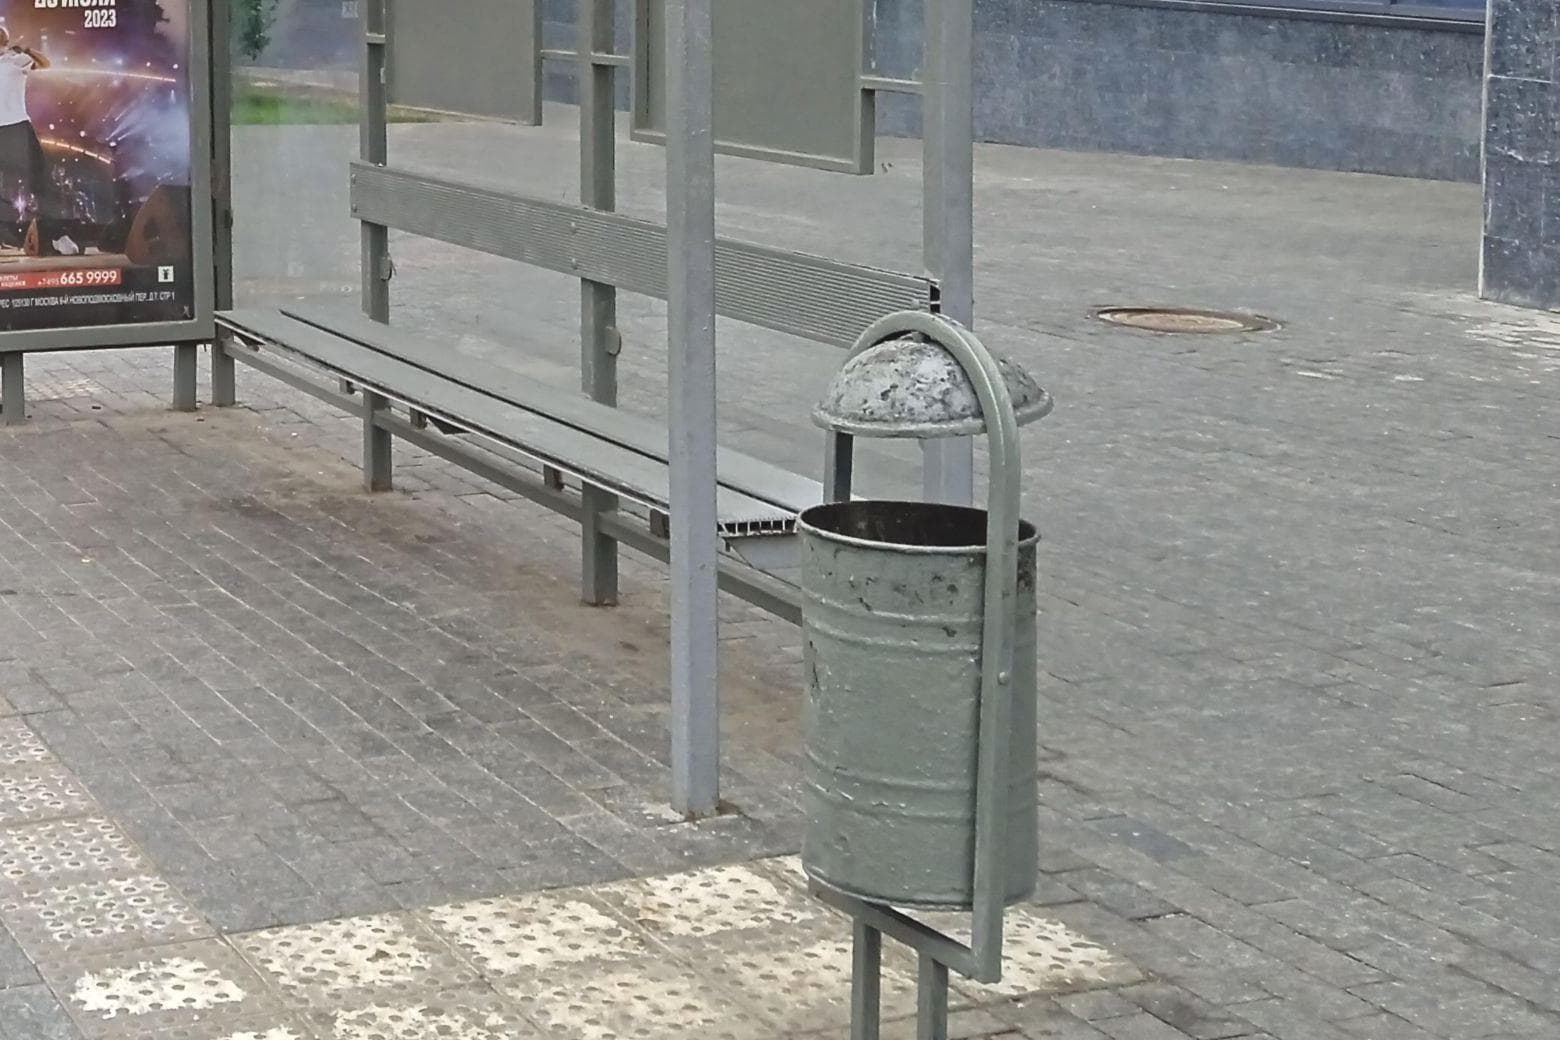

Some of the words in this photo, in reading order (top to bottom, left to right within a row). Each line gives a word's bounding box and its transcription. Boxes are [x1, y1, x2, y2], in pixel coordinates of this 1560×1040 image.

[84, 9, 117, 28] 2023
[60, 272, 83, 285] 665
[86, 271, 117, 285] 9999
